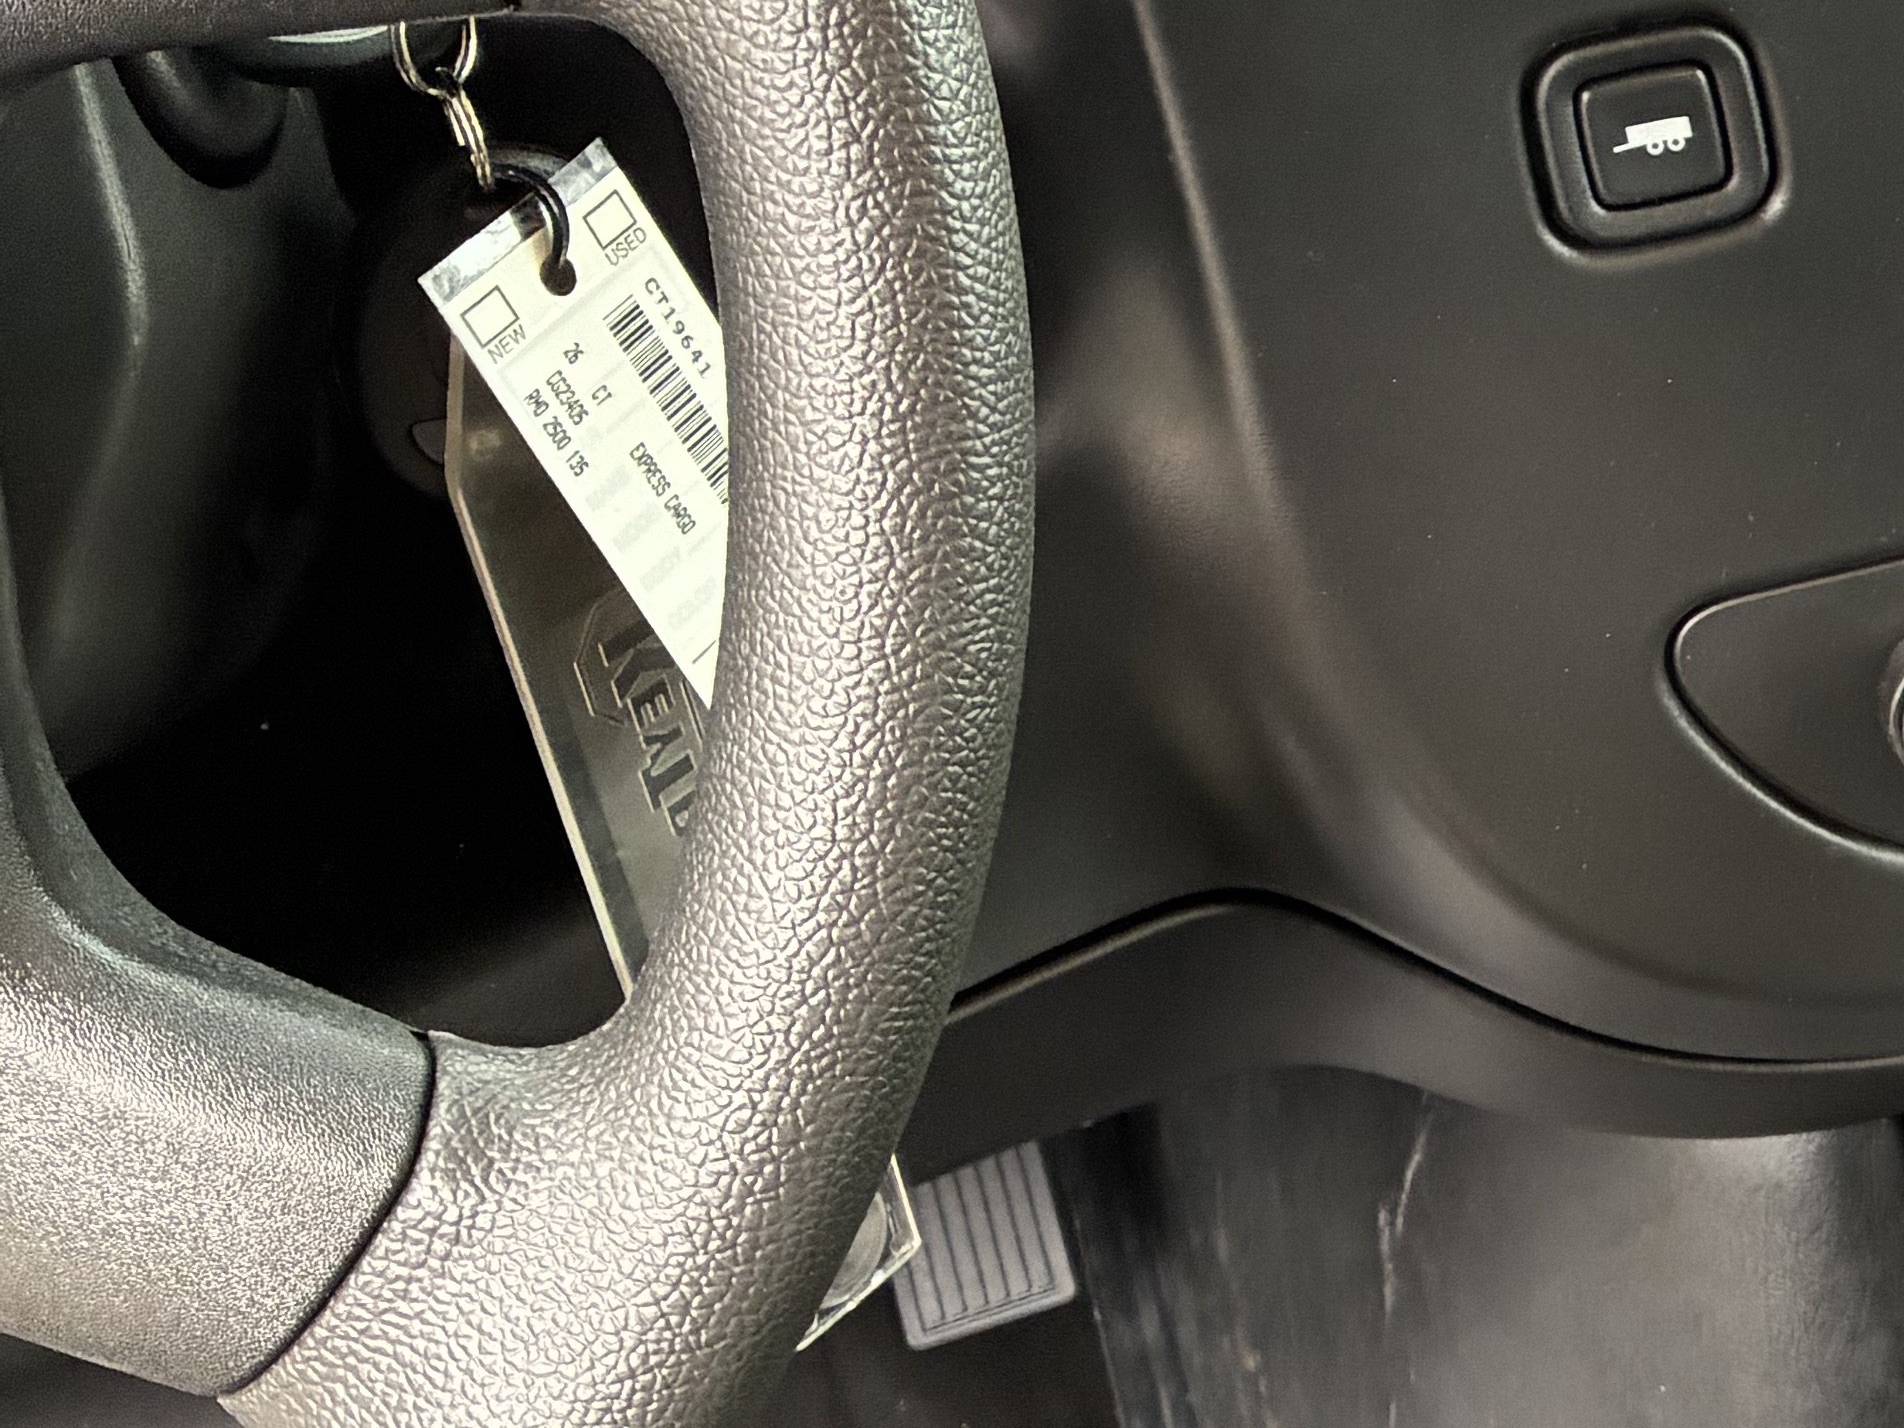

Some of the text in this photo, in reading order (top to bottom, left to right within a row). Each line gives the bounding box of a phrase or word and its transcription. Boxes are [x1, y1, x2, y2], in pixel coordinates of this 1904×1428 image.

[603, 226, 648, 267] USED
[486, 323, 528, 365] NEW
[643, 276, 712, 381] CT19641
[542, 415, 572, 451] 2500
[565, 449, 590, 478] 135
[562, 341, 585, 365] 26
[591, 384, 613, 407] CT
[629, 441, 672, 498] EXPRESS
[663, 493, 697, 536] CARGO
